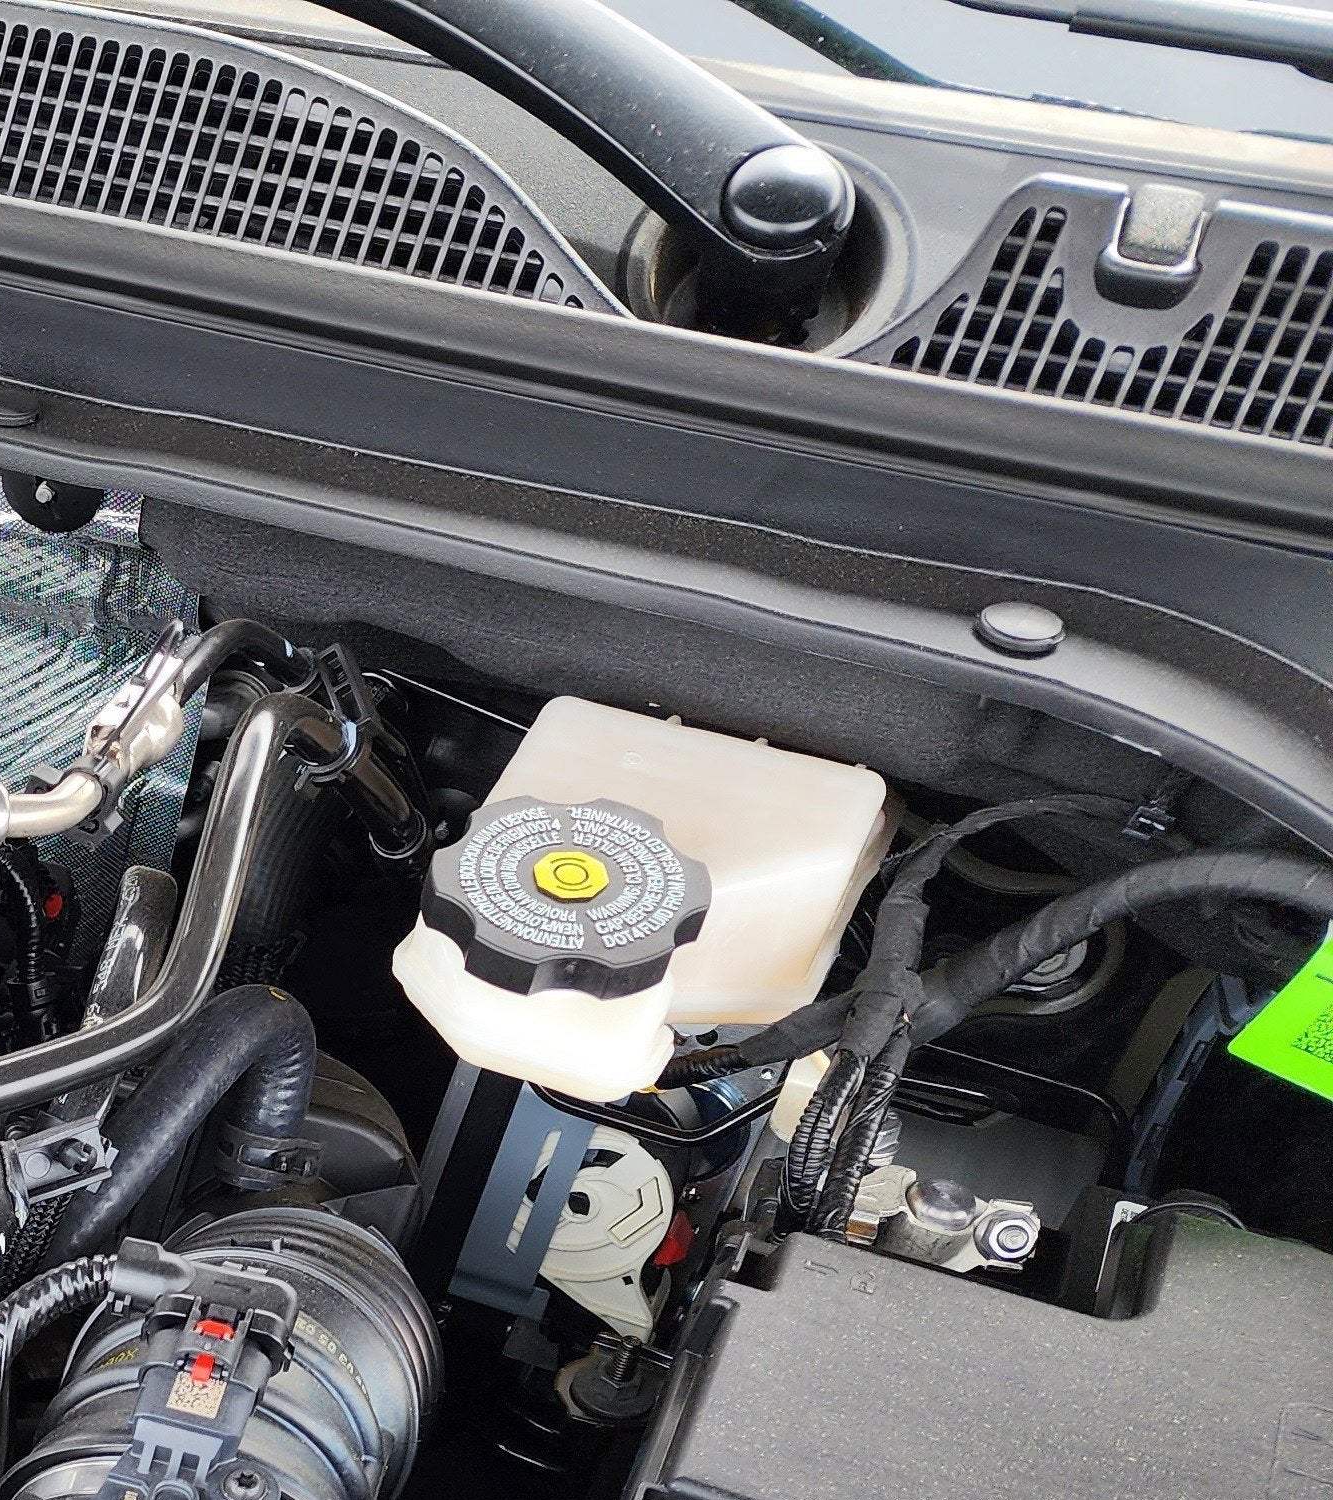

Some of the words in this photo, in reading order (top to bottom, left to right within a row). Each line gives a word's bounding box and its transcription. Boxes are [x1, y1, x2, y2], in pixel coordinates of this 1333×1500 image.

[569, 818, 612, 838] ONLY
[572, 831, 623, 856] FILLER
[641, 834, 684, 873] SEALED
[611, 851, 644, 884] CLEAN
[618, 890, 664, 925] BEFORE
[659, 882, 686, 912] FROM
[592, 915, 630, 934] CAP
[635, 907, 677, 935] FLUID
